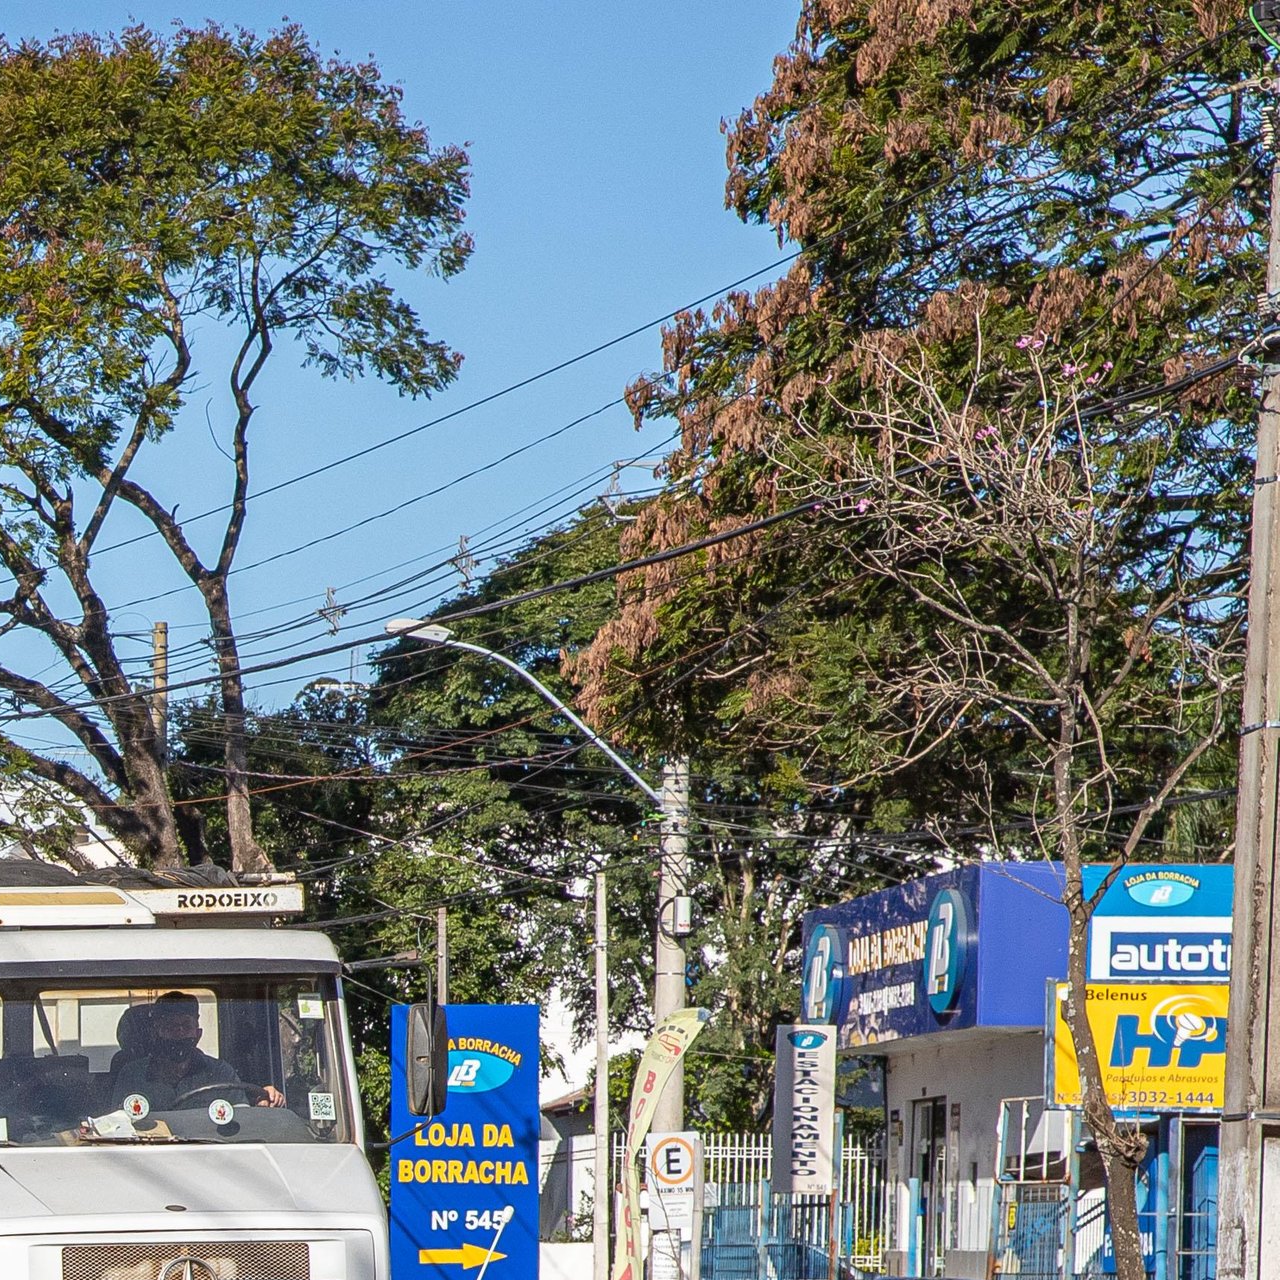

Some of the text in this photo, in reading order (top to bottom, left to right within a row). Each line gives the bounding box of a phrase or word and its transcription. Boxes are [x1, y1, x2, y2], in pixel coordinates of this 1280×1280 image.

[1124, 871, 1200, 888] LOJA DA BORRACHA
[177, 892, 278, 909] RODOEIXO
[1085, 989, 1147, 1001] Belenus
[458, 1038, 522, 1066] BORRACHA
[1109, 1015, 1227, 1068] HP
[1106, 1073, 1158, 1084] Parafusos
[1168, 1073, 1218, 1084] Abrasivos
[1130, 1092, 1214, 1104] 3032-1444
[790, 1051, 819, 1176] ESTACIONAMENTO
[415, 1123, 514, 1147] LOJA DA
[398, 1159, 529, 1185] BORRACHA
[665, 1147, 682, 1175] E
[465, 1210, 505, 1231] 545
